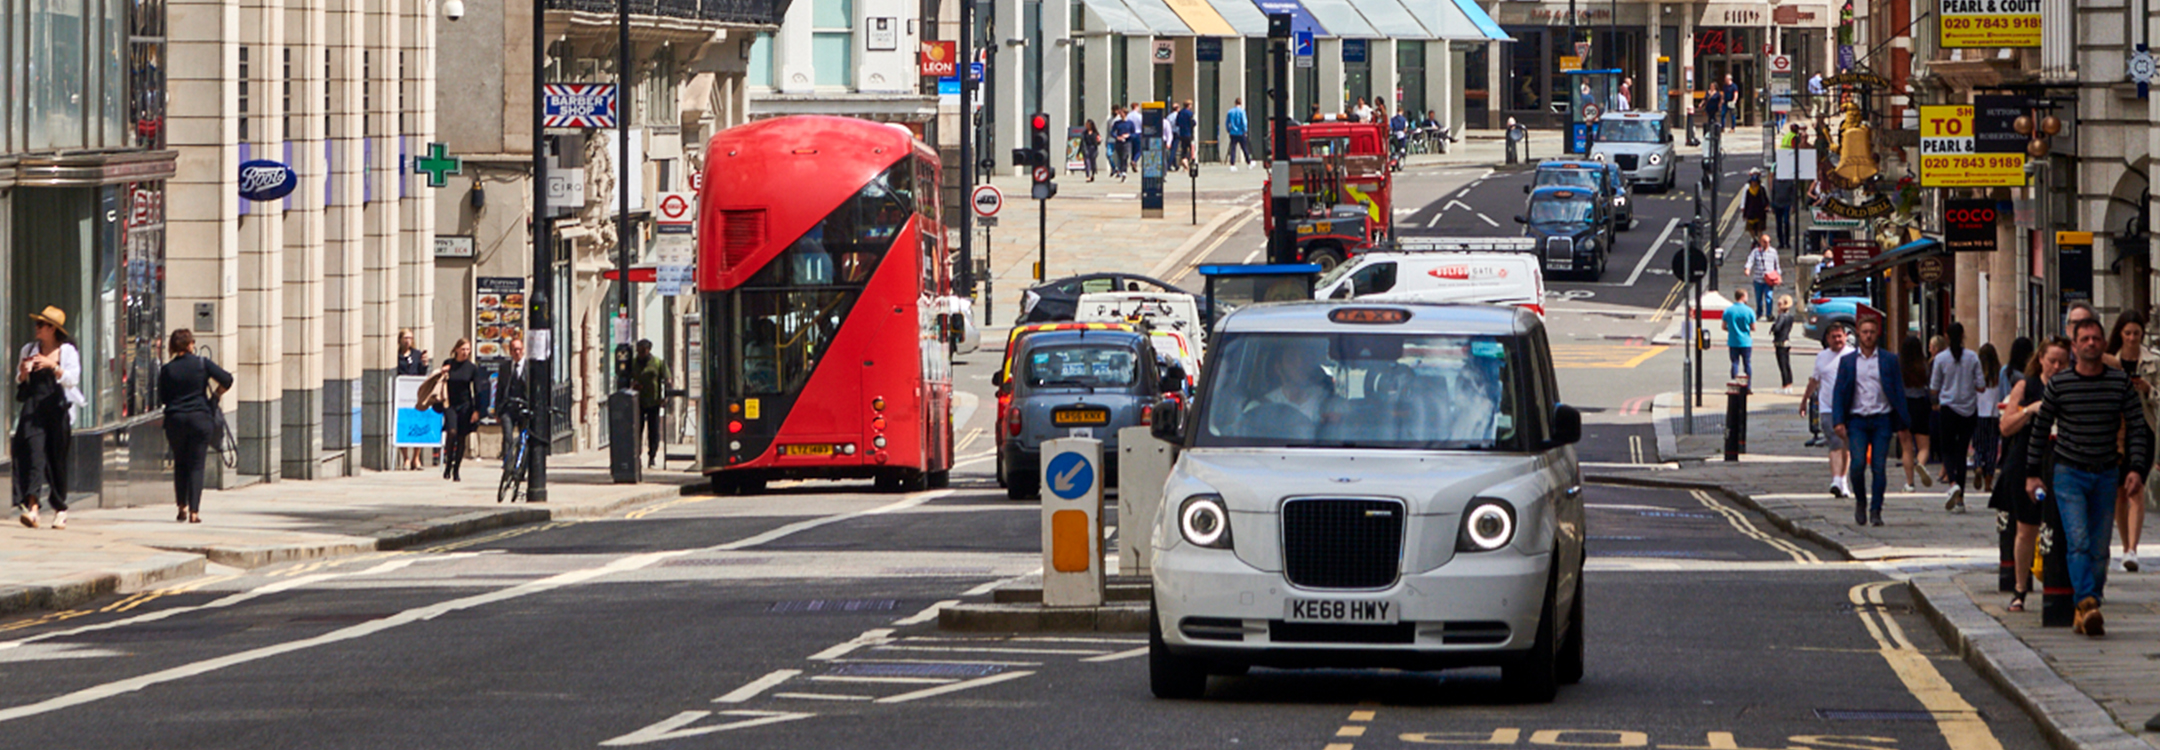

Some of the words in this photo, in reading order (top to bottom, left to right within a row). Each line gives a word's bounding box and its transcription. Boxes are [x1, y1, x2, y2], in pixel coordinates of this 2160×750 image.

[1943, 0, 1983, 13] PEARL
[1986, 0, 1996, 12] &
[1944, 18, 1970, 29] 020
[1975, 17, 2008, 28] 7843
[923, 62, 952, 72] LEON
[551, 96, 603, 106] BARBER
[560, 106, 595, 116] SHOP
[1930, 118, 1962, 135] TO
[1923, 140, 1961, 153] PEARL
[1965, 139, 1974, 153] &
[1924, 158, 1949, 168] 020
[1953, 158, 1985, 168] 7843
[1989, 157, 2022, 168] 9189
[241, 166, 287, 192] Boots
[1827, 201, 1845, 214] THE
[1845, 206, 1867, 217] OLD
[1867, 200, 1890, 214] BELL
[1946, 209, 1995, 222] COCO
[1473, 267, 1493, 275] GATE
[1343, 310, 1396, 320] TAXI
[1293, 600, 1345, 619] KE68
[1350, 601, 1389, 620] HWY
